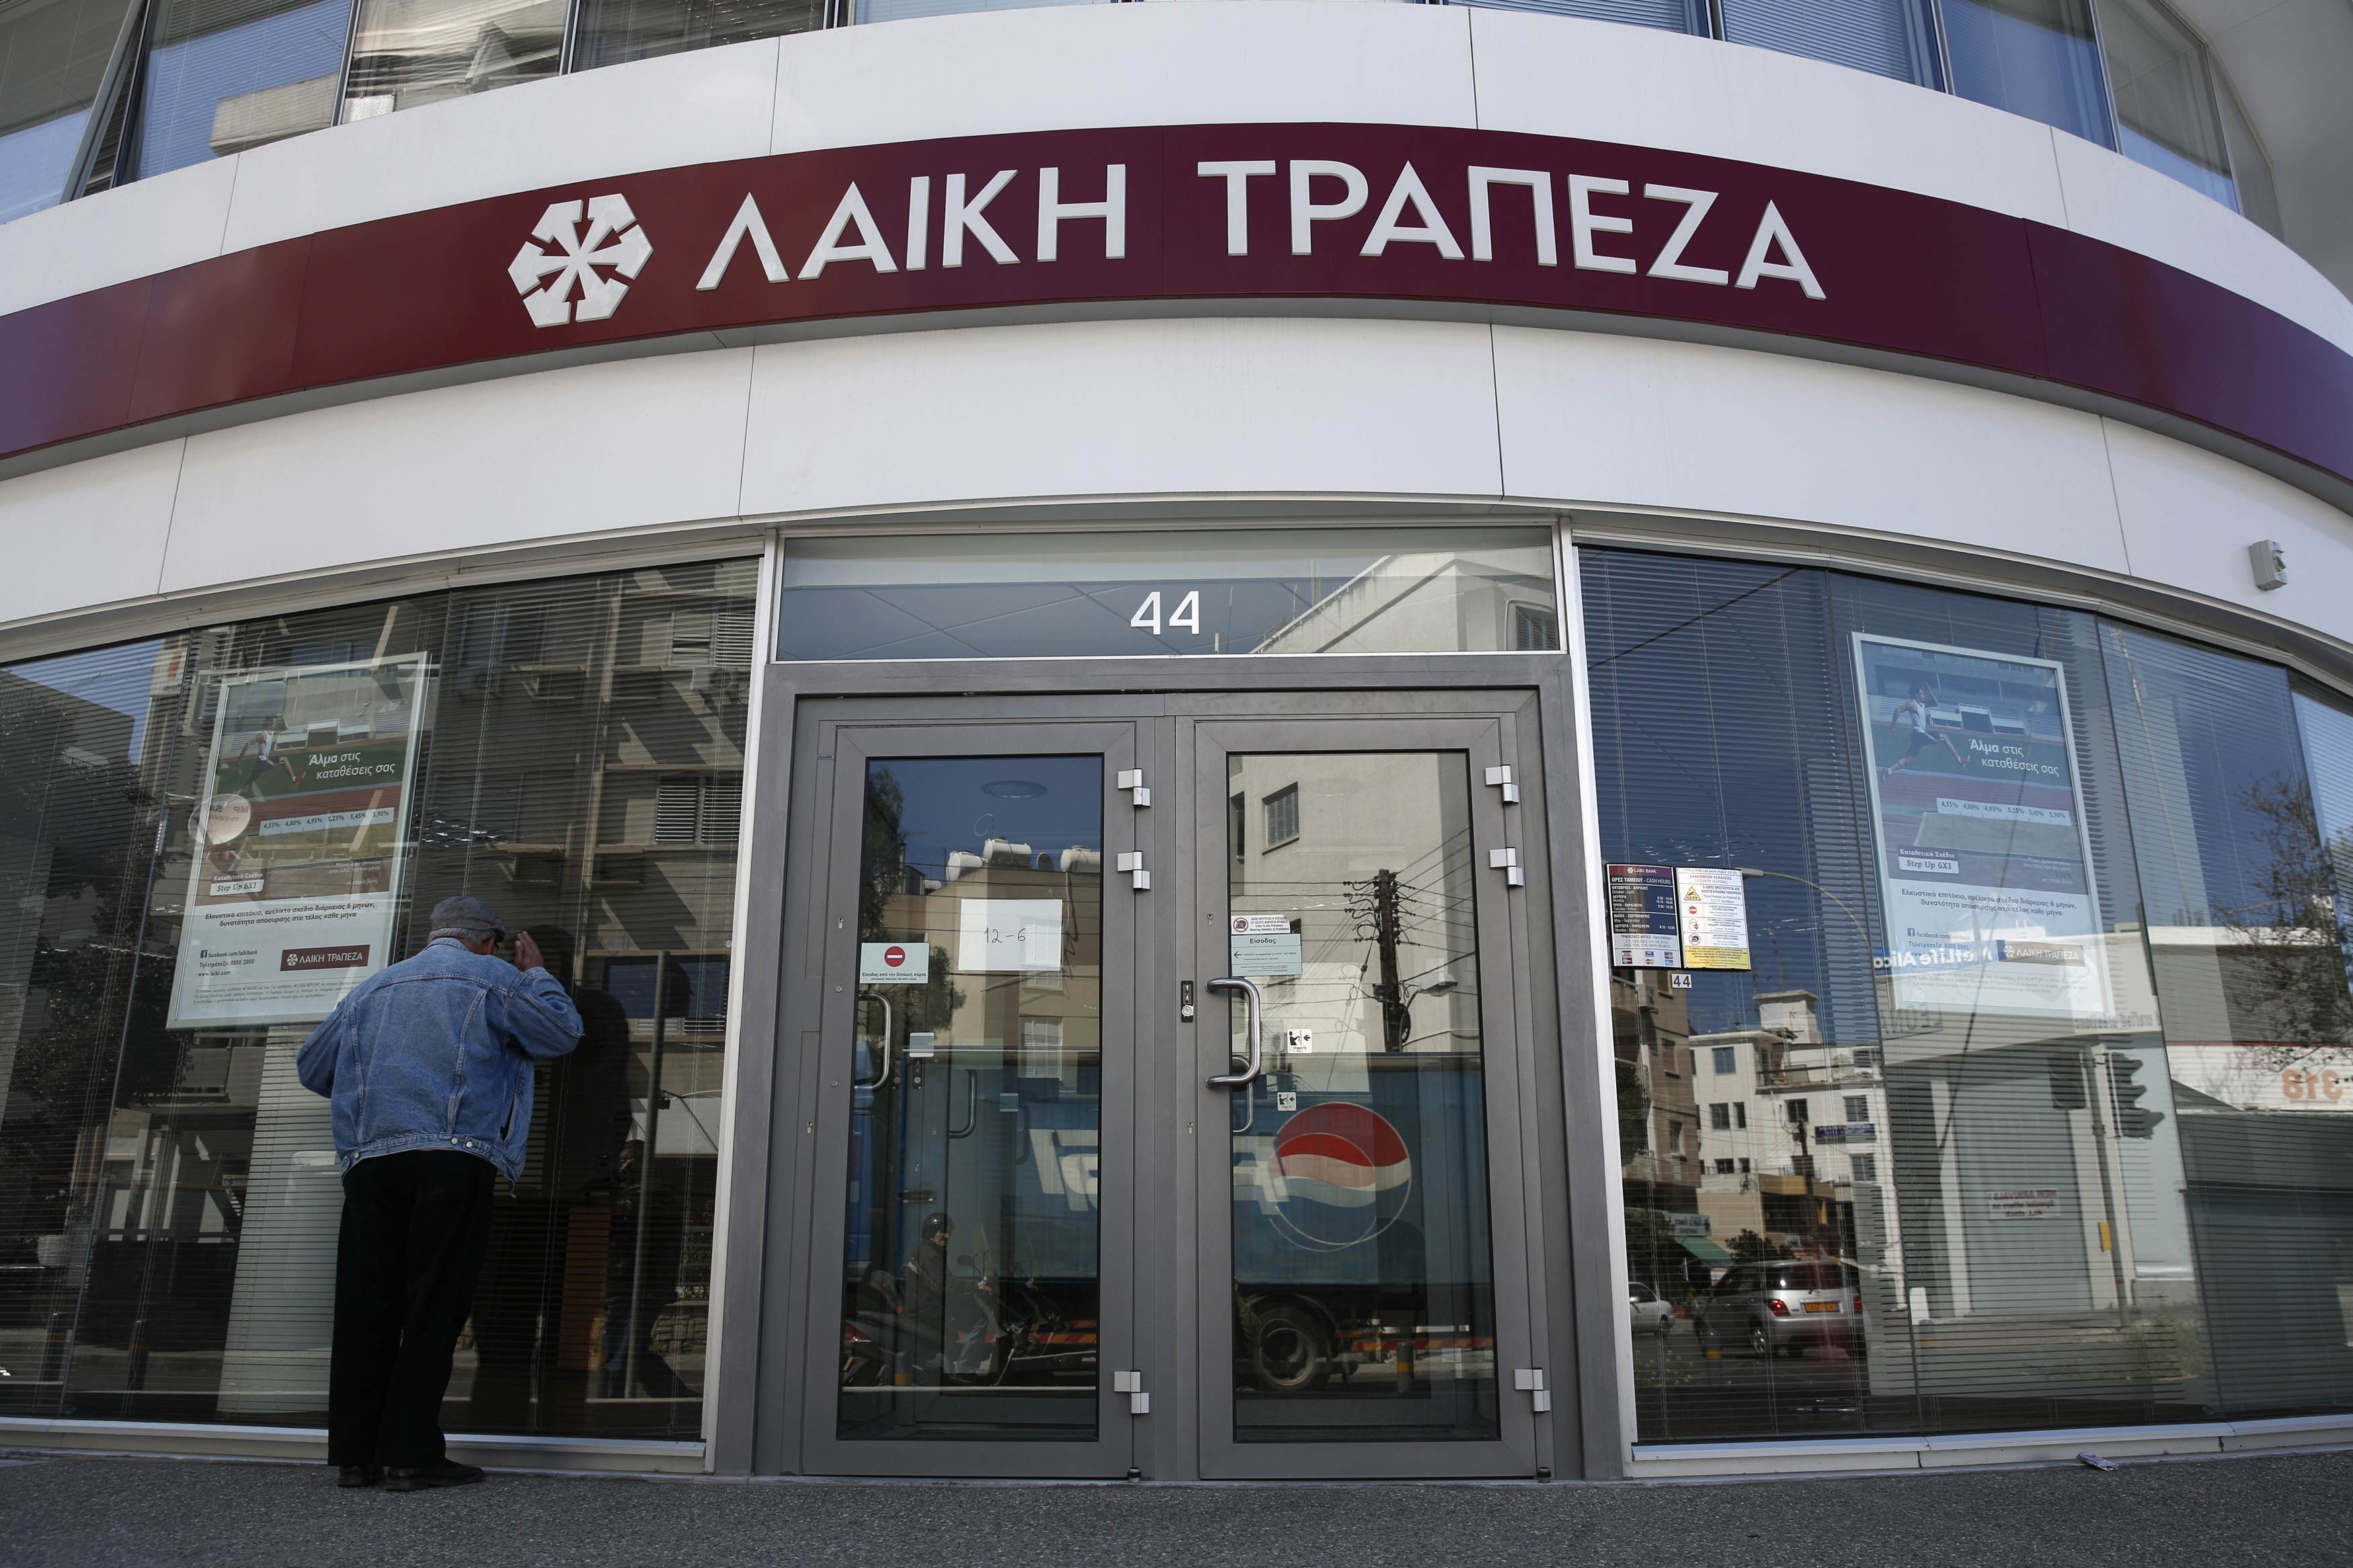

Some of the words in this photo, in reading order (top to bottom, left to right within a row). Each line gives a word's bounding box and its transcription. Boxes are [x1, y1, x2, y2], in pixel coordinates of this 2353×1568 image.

[696, 164, 1125, 290] ΛΑΙΚΗ
[1197, 160, 1827, 300] ΤΡΑΠΕΖΑ
[1131, 591, 1199, 635] 44
[1968, 738, 1999, 755] Άλμα
[2002, 746, 2024, 757] στις
[309, 753, 337, 767] Άλμα
[340, 752, 361, 762] στις
[1981, 757, 2039, 774] καταθέσεις
[2041, 765, 2059, 777] σας
[317, 765, 373, 779] καταθέσεις
[376, 764, 396, 774] σας
[1941, 800, 1958, 809] 4,55%
[1899, 848, 1933, 857] Καταθετικό
[1907, 860, 1922, 869] Step
[1925, 861, 1936, 870] Up
[1938, 862, 1952, 870] 6X1
[233, 883, 243, 891] Up
[1902, 888, 1936, 897] Ελκυστικό
[1938, 893, 1967, 901] επιτόκιο,
[2020, 897, 2049, 907] διάρκειας
[2056, 901, 2077, 910] μηνών,
[1921, 899, 1960, 909] δυνατότητα
[1961, 903, 1997, 912] απόσυρσης
[2012, 906, 2030, 914] τέλος
[205, 911, 235, 919] Ελκυστικό
[236, 909, 263, 917] επιτόκιο,
[315, 903, 346, 911] διάρκειας
[352, 901, 375, 909] μηνών,
[220, 919, 255, 927] δυνατότητα
[340, 911, 356, 919] μήνα
[299, 954, 324, 964] ΛΑΙΚΗ
[328, 952, 363, 962] ΤΡΑΠΕΖΑ
[2016, 948, 2042, 958] ΛΑΙΚΗ
[2044, 949, 2080, 960] ΤΡΑΠΕΖΑ
[1673, 975, 1690, 987] 44
